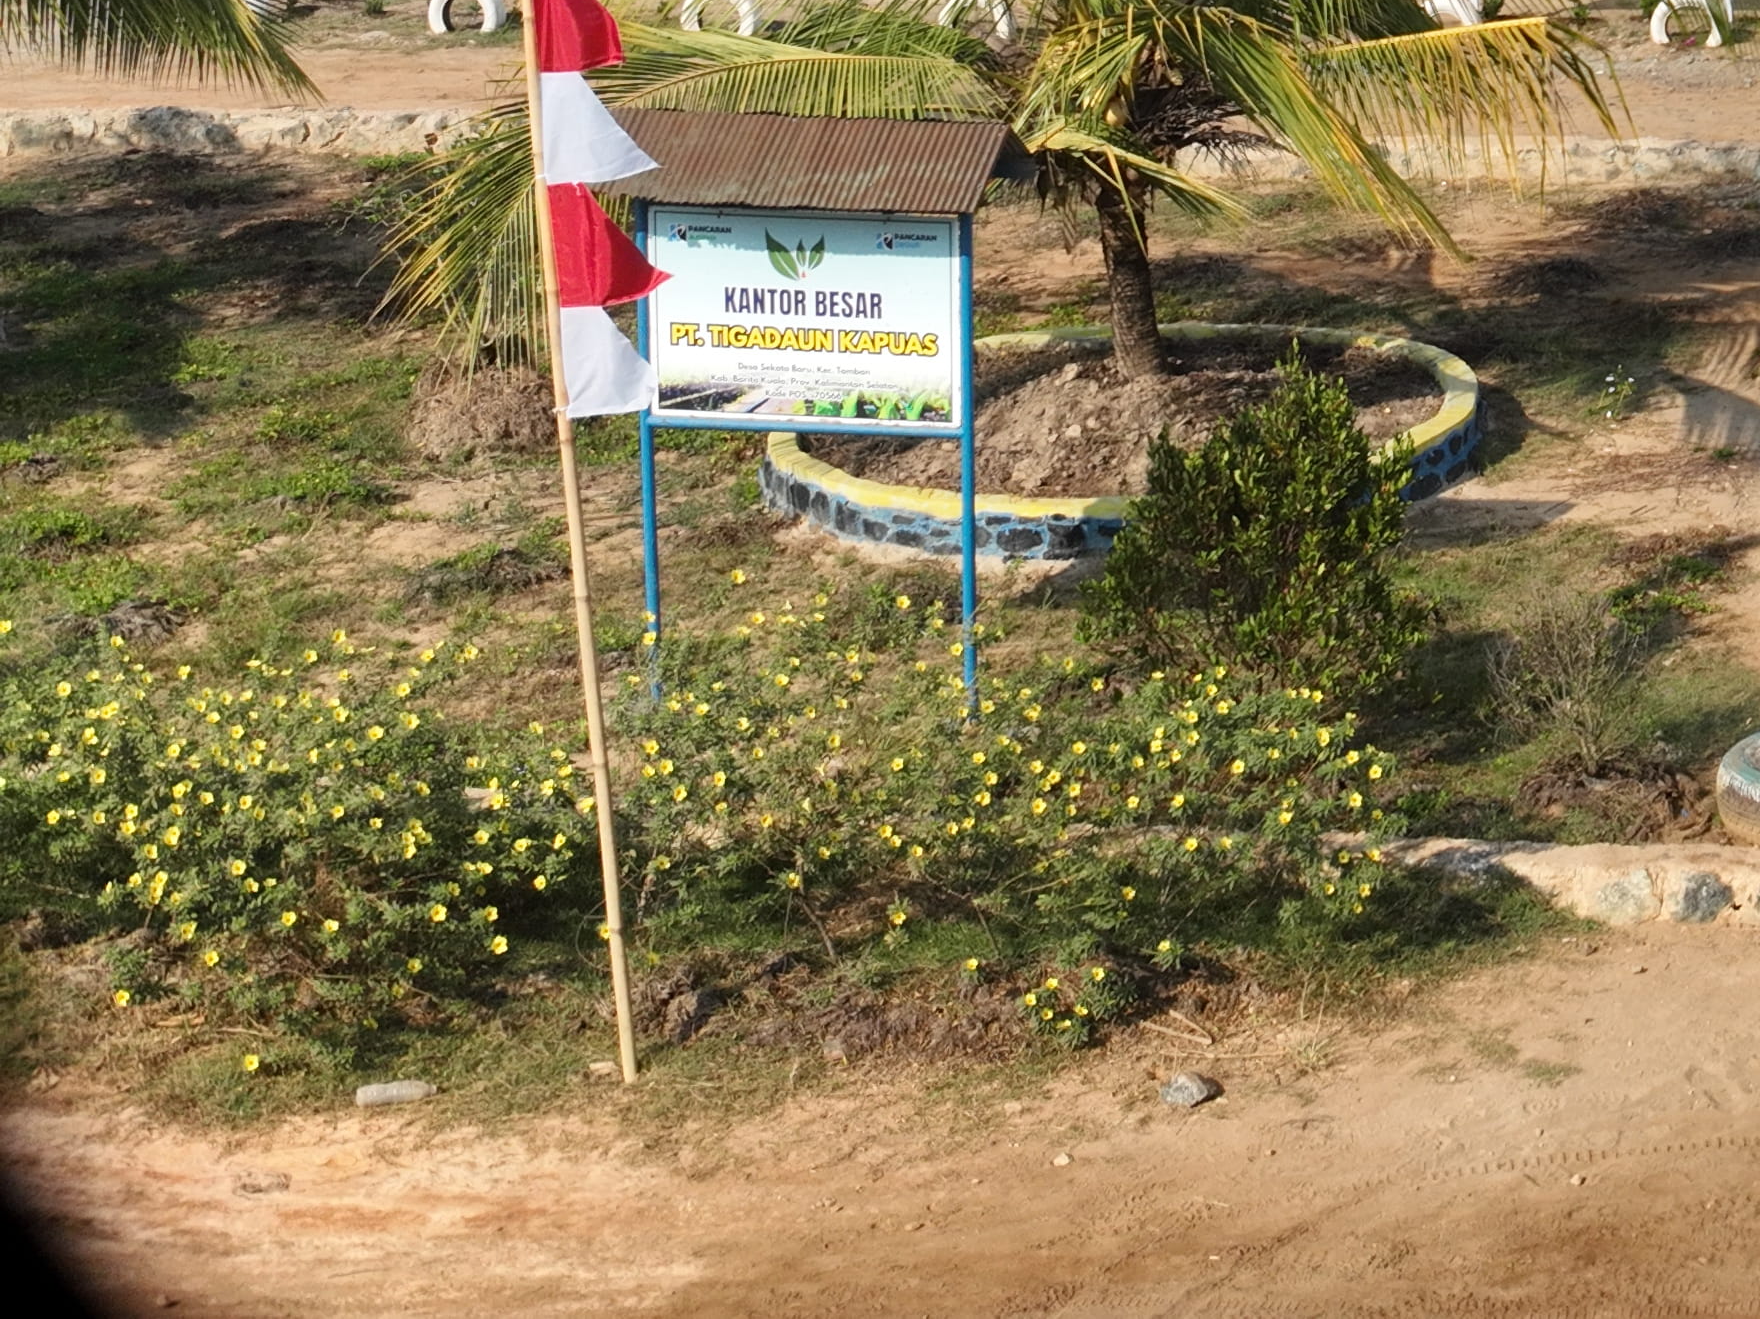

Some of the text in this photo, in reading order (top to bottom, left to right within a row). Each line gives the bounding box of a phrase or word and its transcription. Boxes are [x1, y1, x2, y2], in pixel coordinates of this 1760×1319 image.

[688, 225, 732, 233] PANCARAN
[894, 233, 937, 241] PANCARAN
[724, 286, 882, 319] KANTOR BESAR
[670, 322, 939, 357] PT. TIGADAUN KAPUAS
